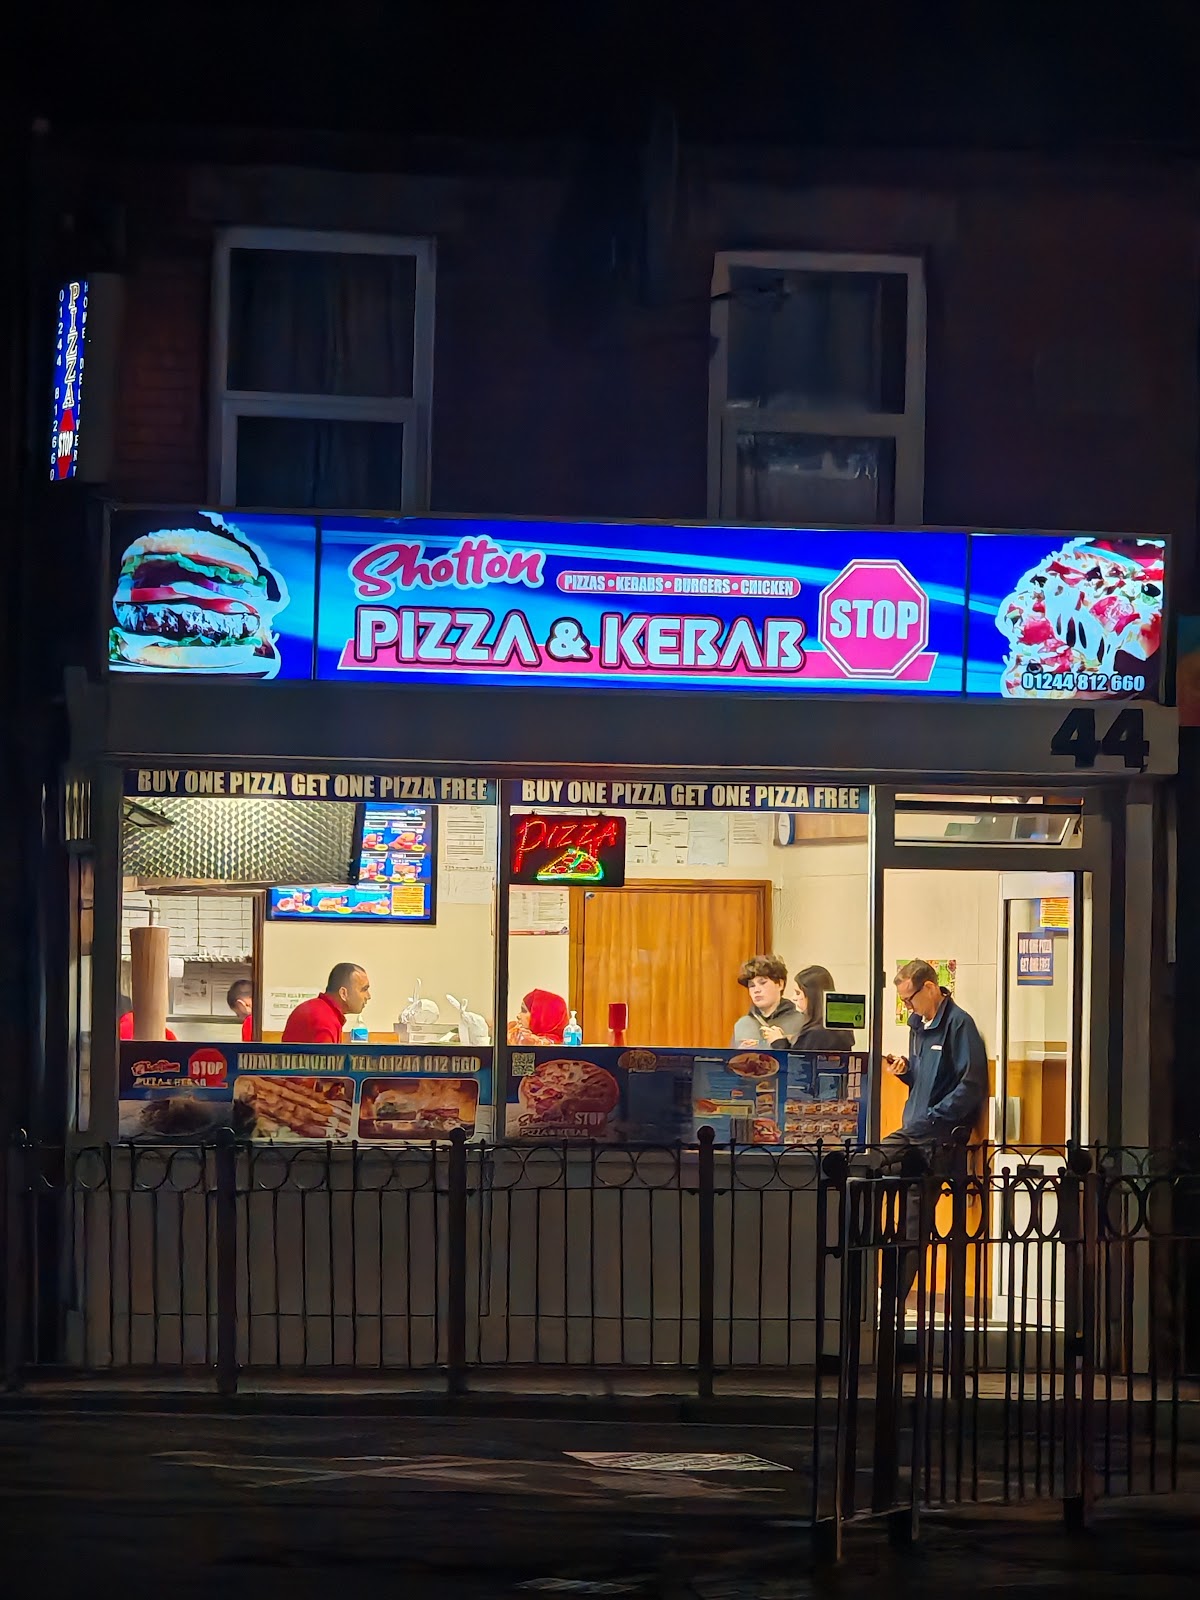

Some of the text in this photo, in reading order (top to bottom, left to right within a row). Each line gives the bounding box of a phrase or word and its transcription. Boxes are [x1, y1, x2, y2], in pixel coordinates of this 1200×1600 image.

[55, 289, 65, 367] 01244
[61, 282, 80, 410] PIZZA
[57, 429, 74, 459] STOP
[352, 537, 543, 598] Shotton
[564, 575, 794, 596] PIZZAS KEBABS BURGERS CHICKEN
[355, 607, 804, 670] PIZZA & KEBAB
[829, 600, 919, 640] STOP
[1021, 672, 1146, 692] 01244 812 660
[1051, 708, 1150, 761] 44
[138, 769, 488, 800] BUY ONE PIZZA GET ONE PIZZA FREE
[522, 779, 860, 809] BUY ONE PIZZA GET ONE PIZZA FREE
